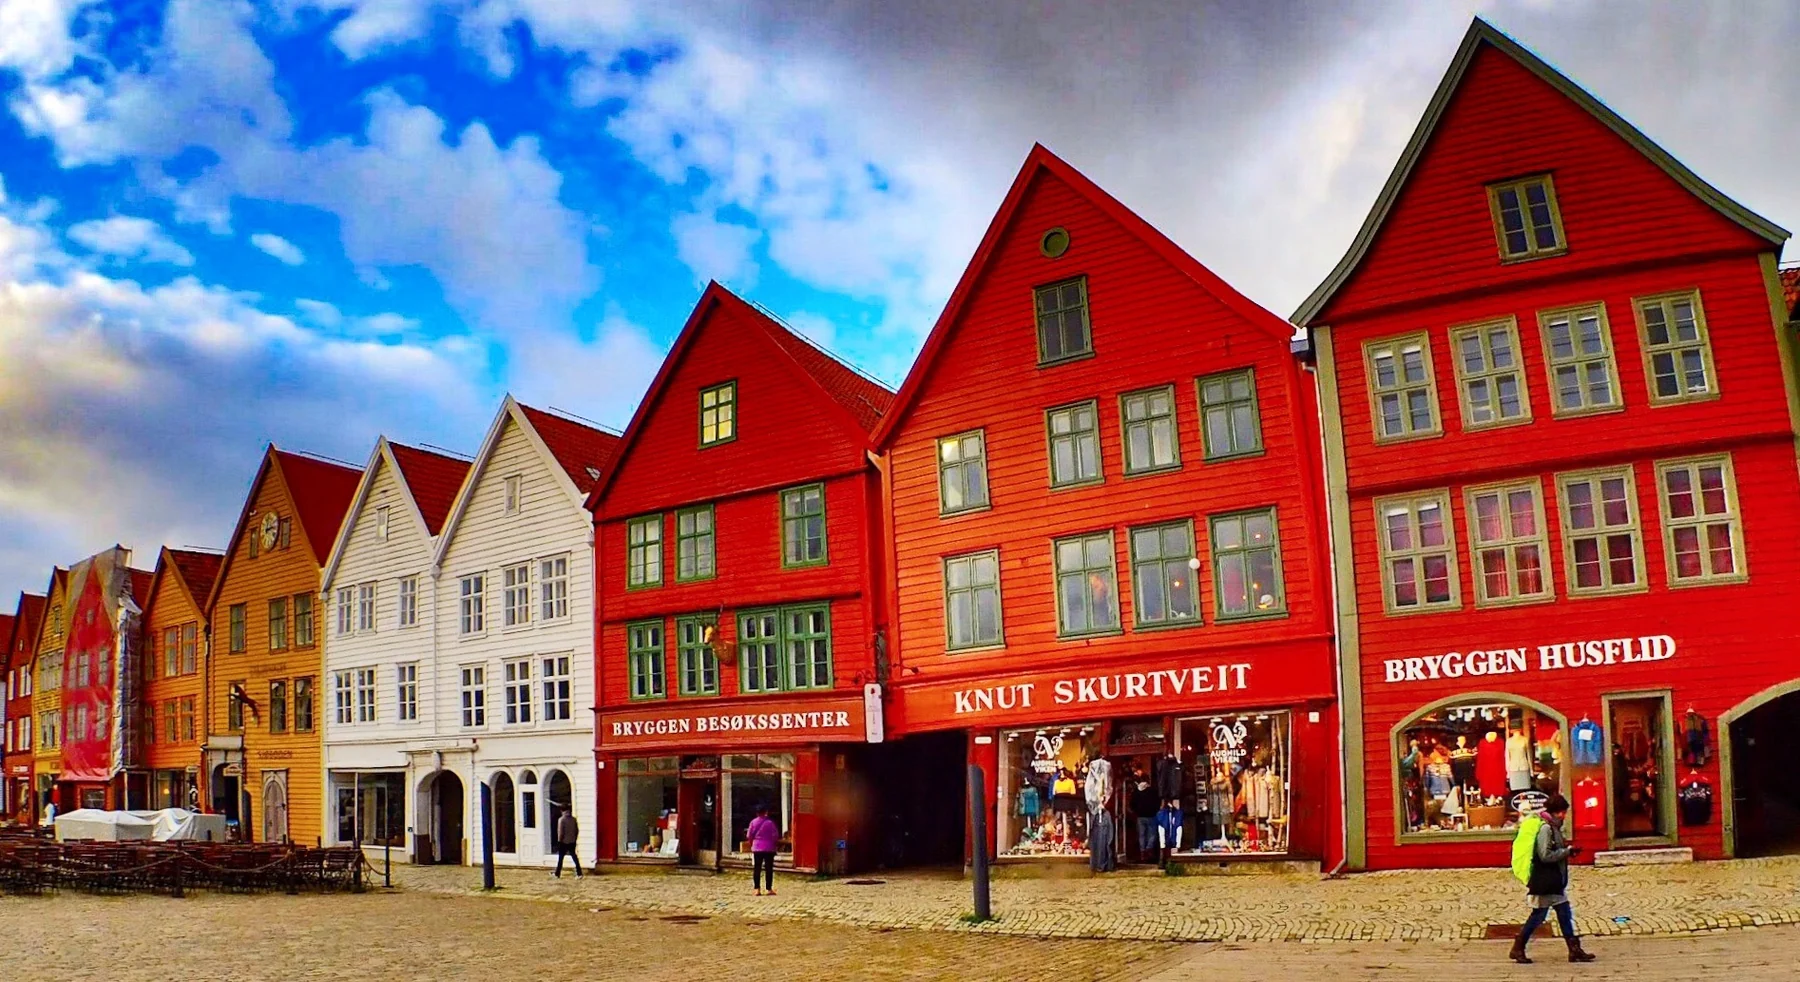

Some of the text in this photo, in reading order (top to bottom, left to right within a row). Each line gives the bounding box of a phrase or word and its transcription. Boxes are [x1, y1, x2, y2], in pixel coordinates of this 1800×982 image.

[1383, 634, 1677, 683] BRYGGEN HUSFLID
[953, 663, 1252, 714] KNUT SKURTVEIT
[612, 718, 690, 736] BRYGGEN
[696, 711, 850, 732] BESØKSSENTER
[1210, 748, 1247, 758] AUDHILD
[1215, 756, 1240, 764] VIKEN
